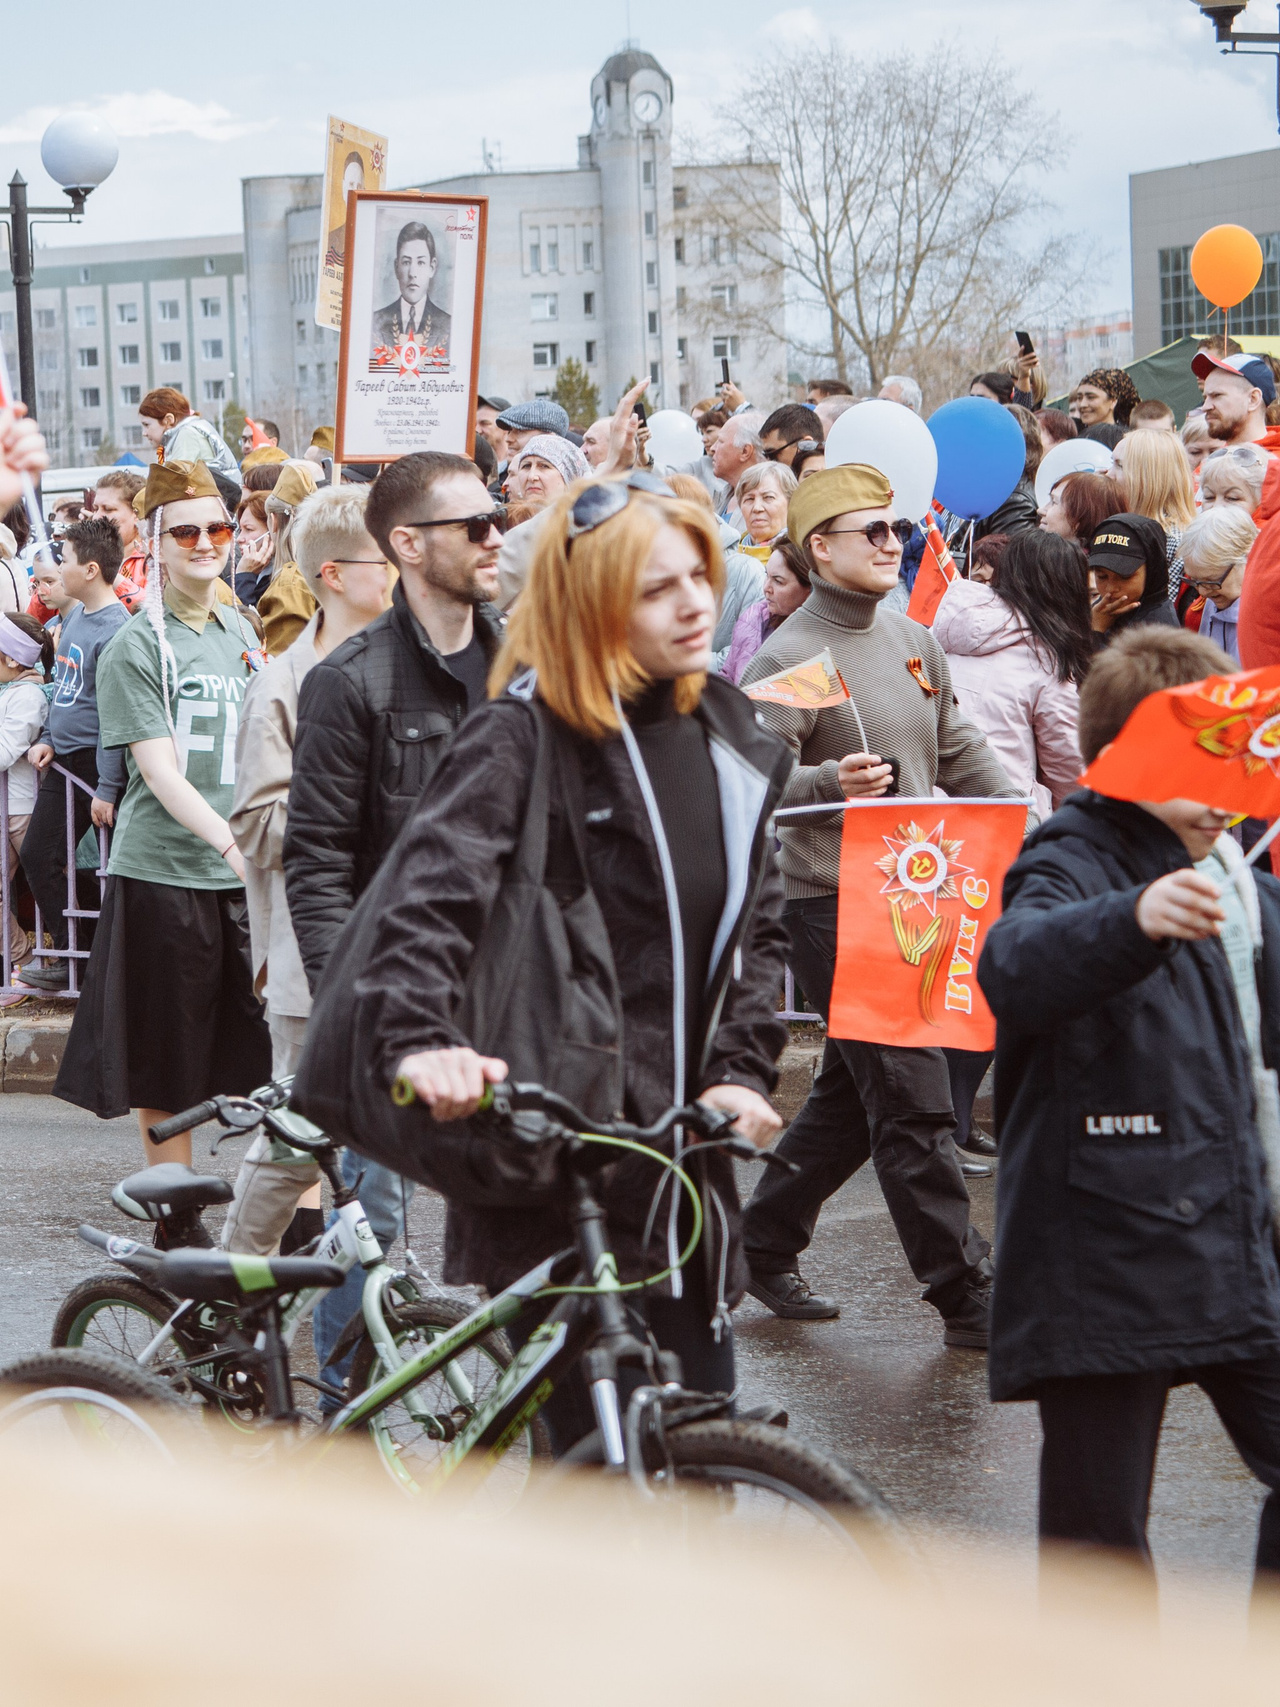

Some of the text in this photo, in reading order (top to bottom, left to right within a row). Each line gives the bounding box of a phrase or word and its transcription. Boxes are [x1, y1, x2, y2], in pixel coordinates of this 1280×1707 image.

[355, 379, 464, 397] Гареев Сабит Абдулович
[1094, 533, 1130, 547] NEW YORK
[945, 876, 989, 1014] 9 МАЯ
[1086, 1114, 1161, 1135] LEVEL
